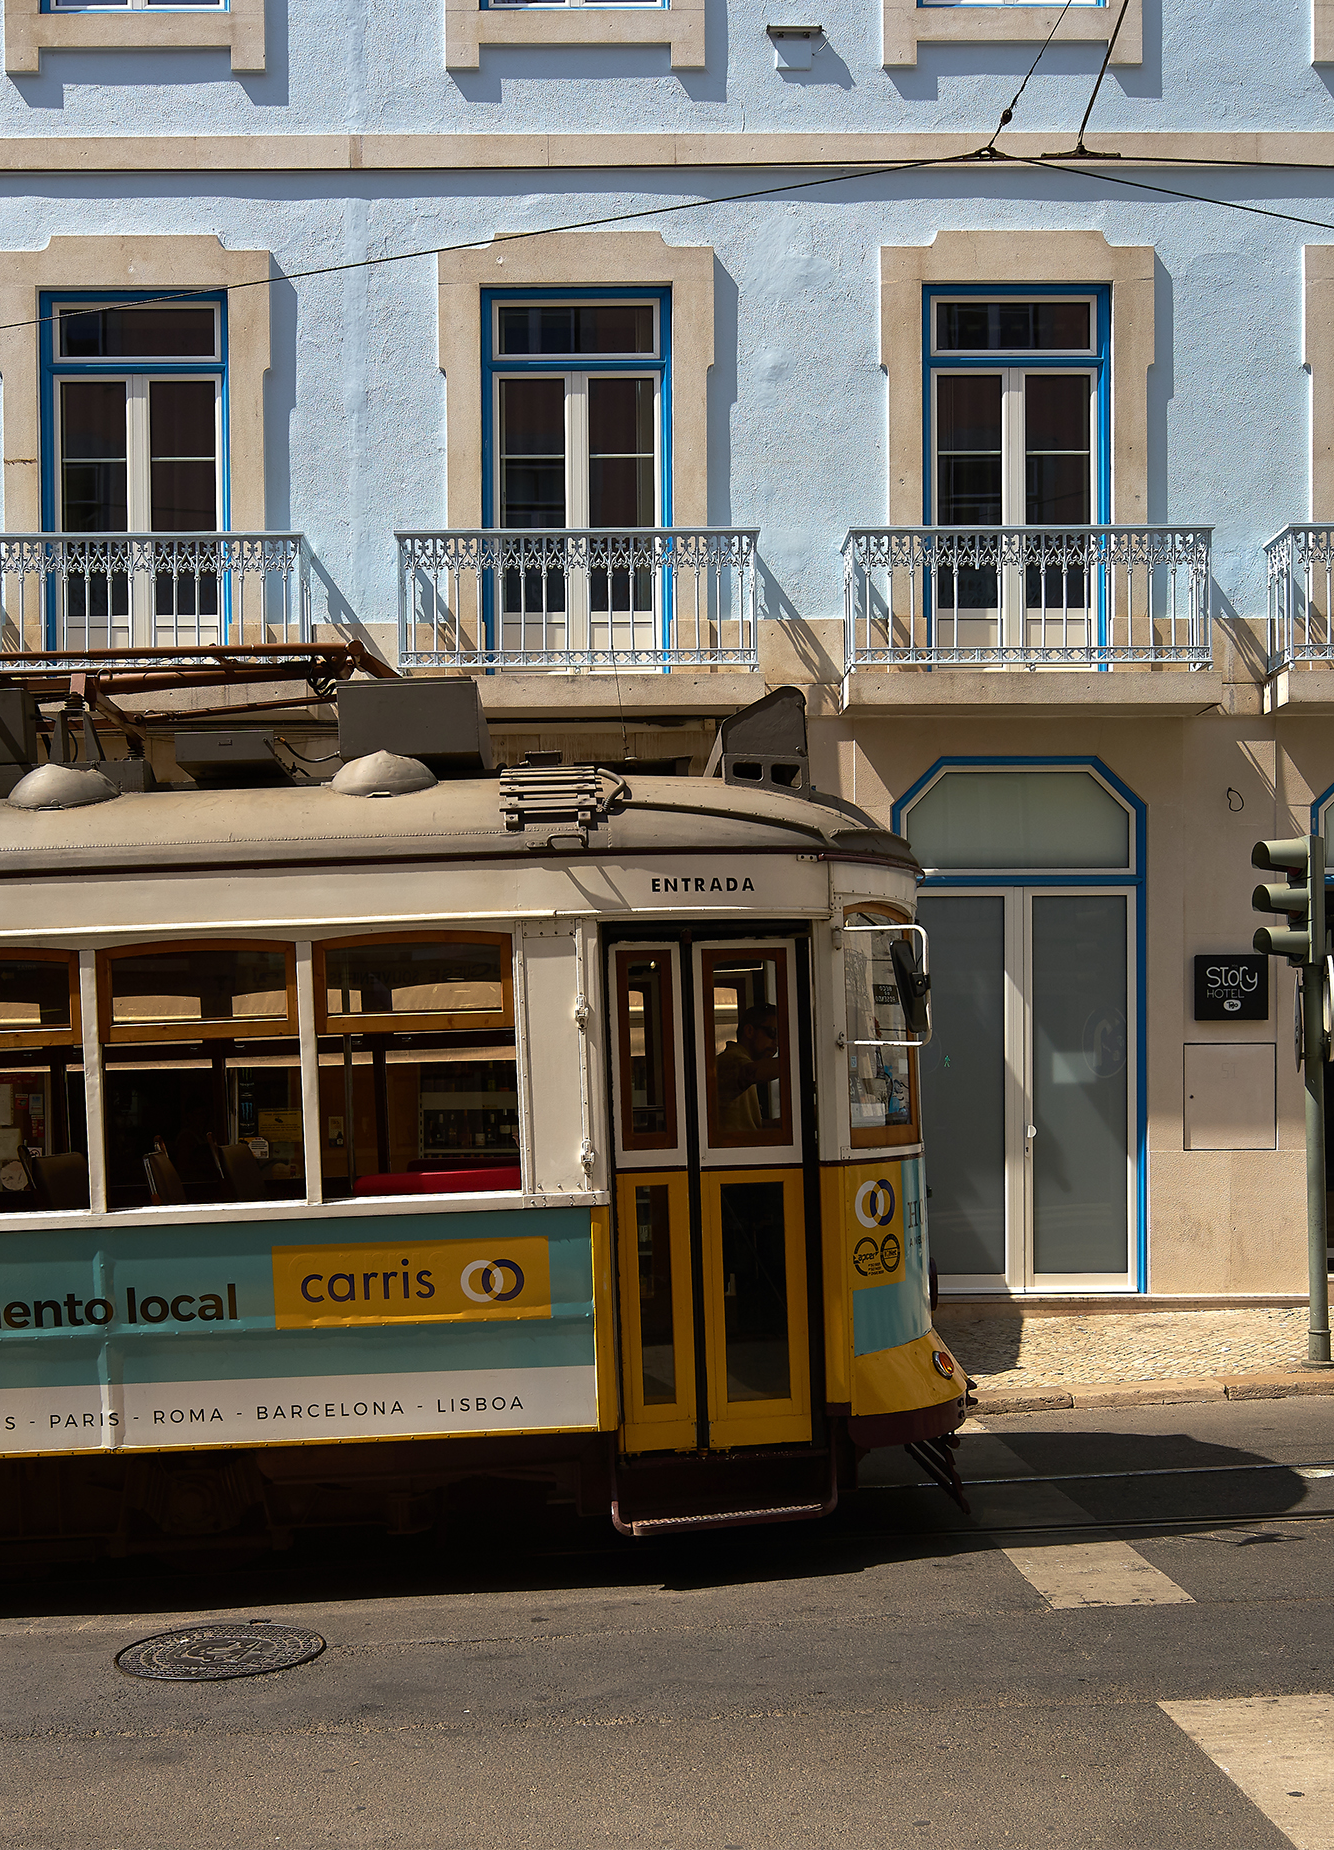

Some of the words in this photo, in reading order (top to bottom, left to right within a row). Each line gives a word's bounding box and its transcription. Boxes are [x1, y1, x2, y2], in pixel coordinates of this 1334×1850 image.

[651, 877, 756, 893] ENTRADA
[1207, 989, 1245, 999] HOTEL
[300, 1258, 436, 1303] carris
[126, 1283, 238, 1325] local
[49, 1410, 120, 1429] PARIS
[153, 1407, 224, 1425] ROMA
[256, 1400, 405, 1421] BARCELONA
[437, 1395, 525, 1413] LISBOA
